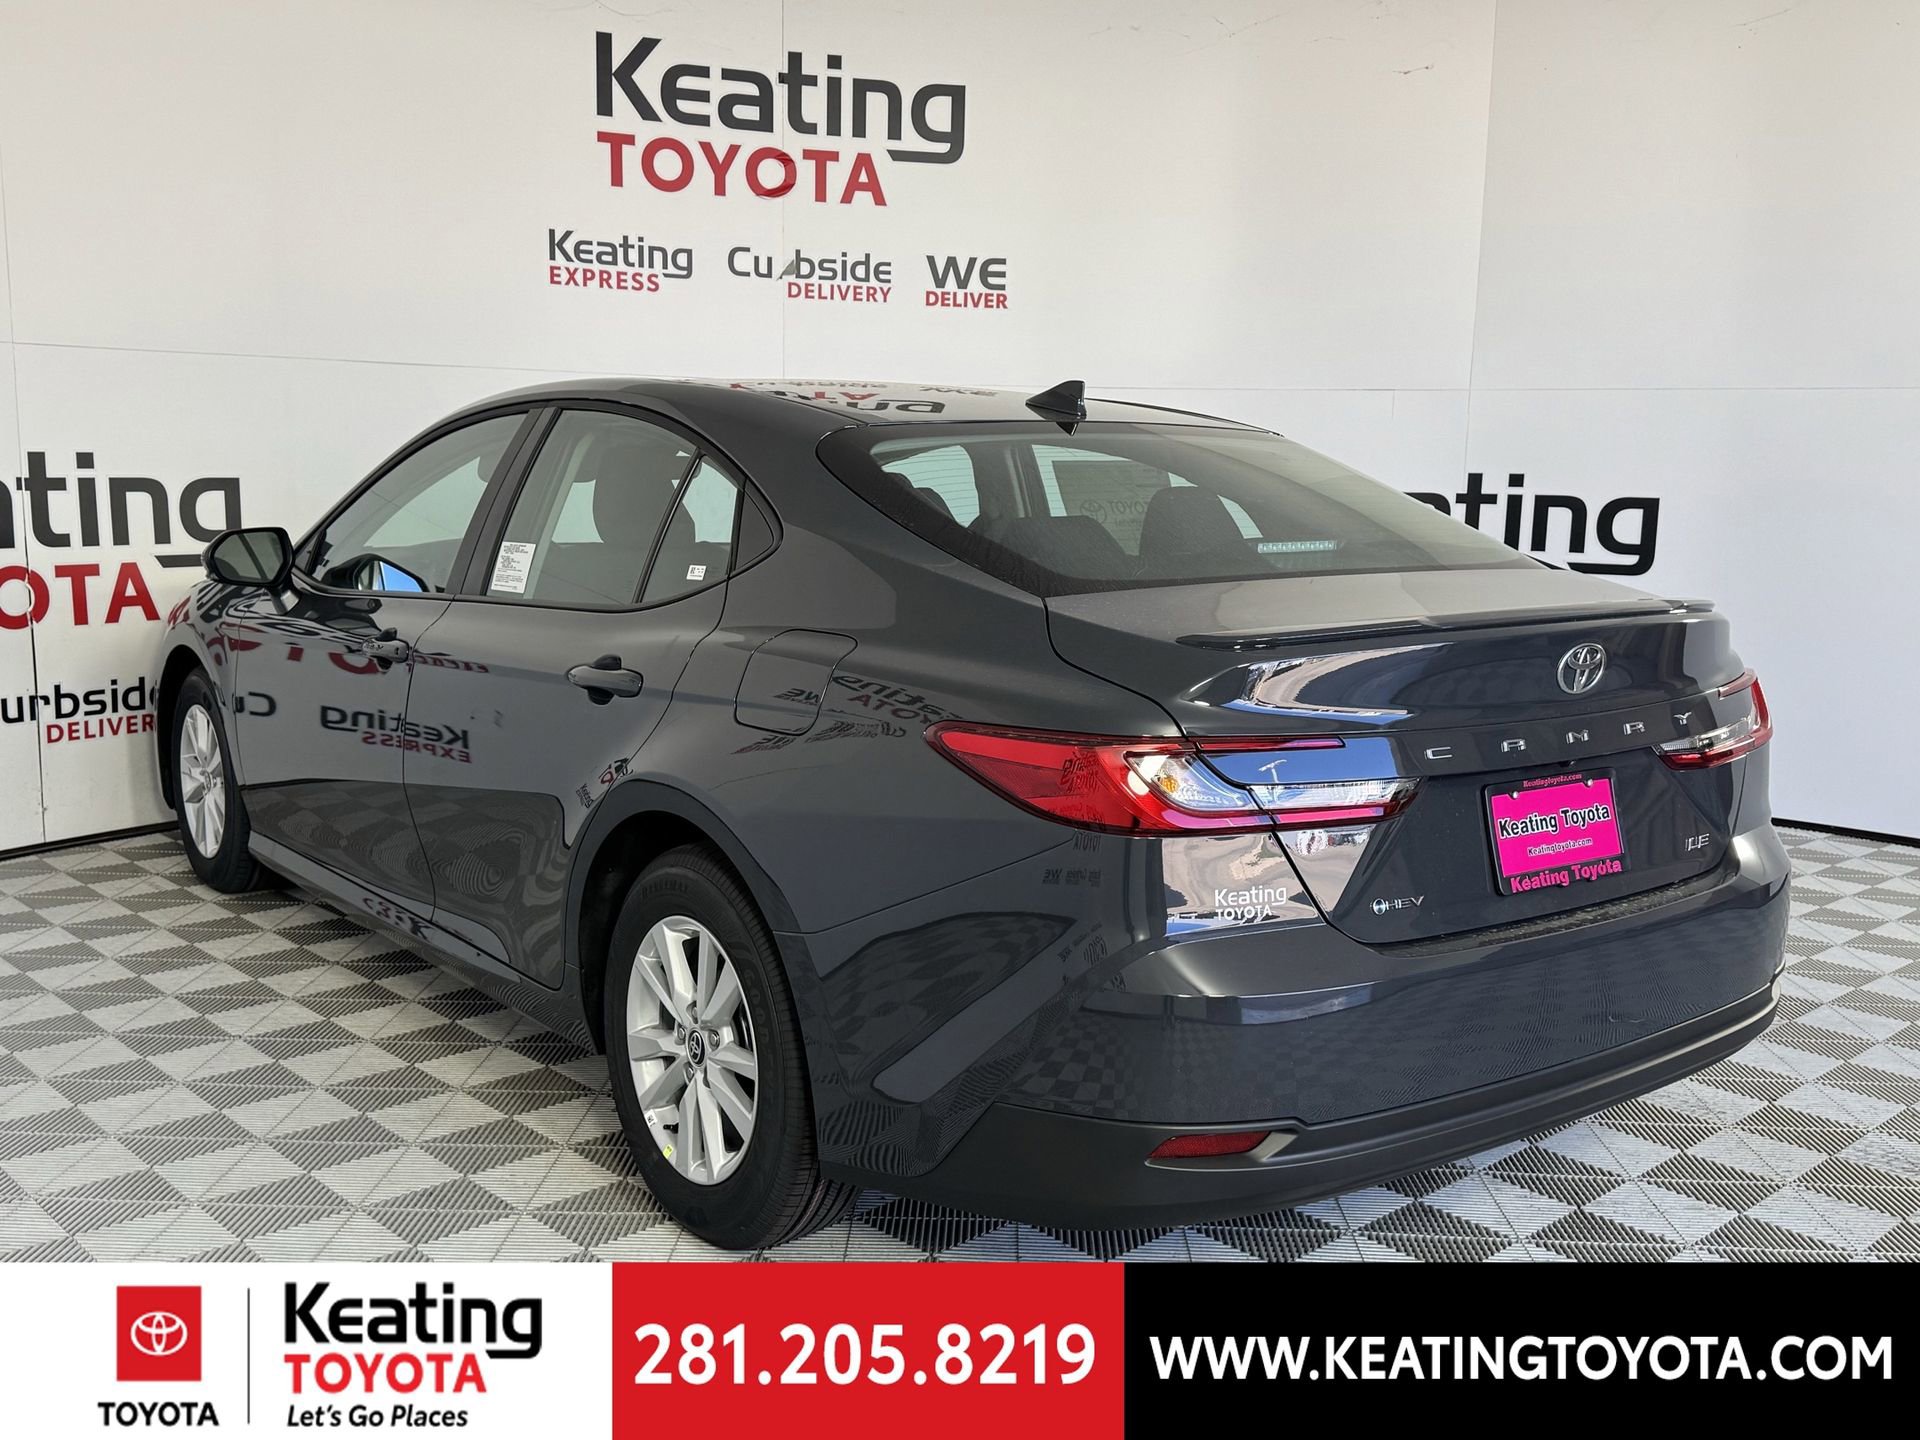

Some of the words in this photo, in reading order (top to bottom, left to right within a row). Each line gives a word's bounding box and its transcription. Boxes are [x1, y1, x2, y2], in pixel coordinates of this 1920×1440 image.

[595, 31, 966, 164] Keating
[596, 131, 887, 206] TOYOTA
[548, 228, 693, 279] Keating
[727, 246, 892, 284] Cubside
[549, 266, 660, 292] EXPRESS
[925, 255, 1007, 291] WE
[787, 281, 891, 303] DELIVERY
[925, 291, 1008, 309] DELIVER
[0, 451, 243, 569] ting
[1, 676, 158, 723] urbsid
[1424, 711, 1692, 760] CAMRY
[1499, 812, 1558, 838] Keating
[1561, 804, 1611, 829] Toyota
[1510, 870, 1570, 893] Keating
[1571, 859, 1622, 880] Toyota
[1214, 885, 1287, 909] Keating
[1215, 906, 1273, 920] TOYOTA
[1385, 896, 1425, 910] HEV
